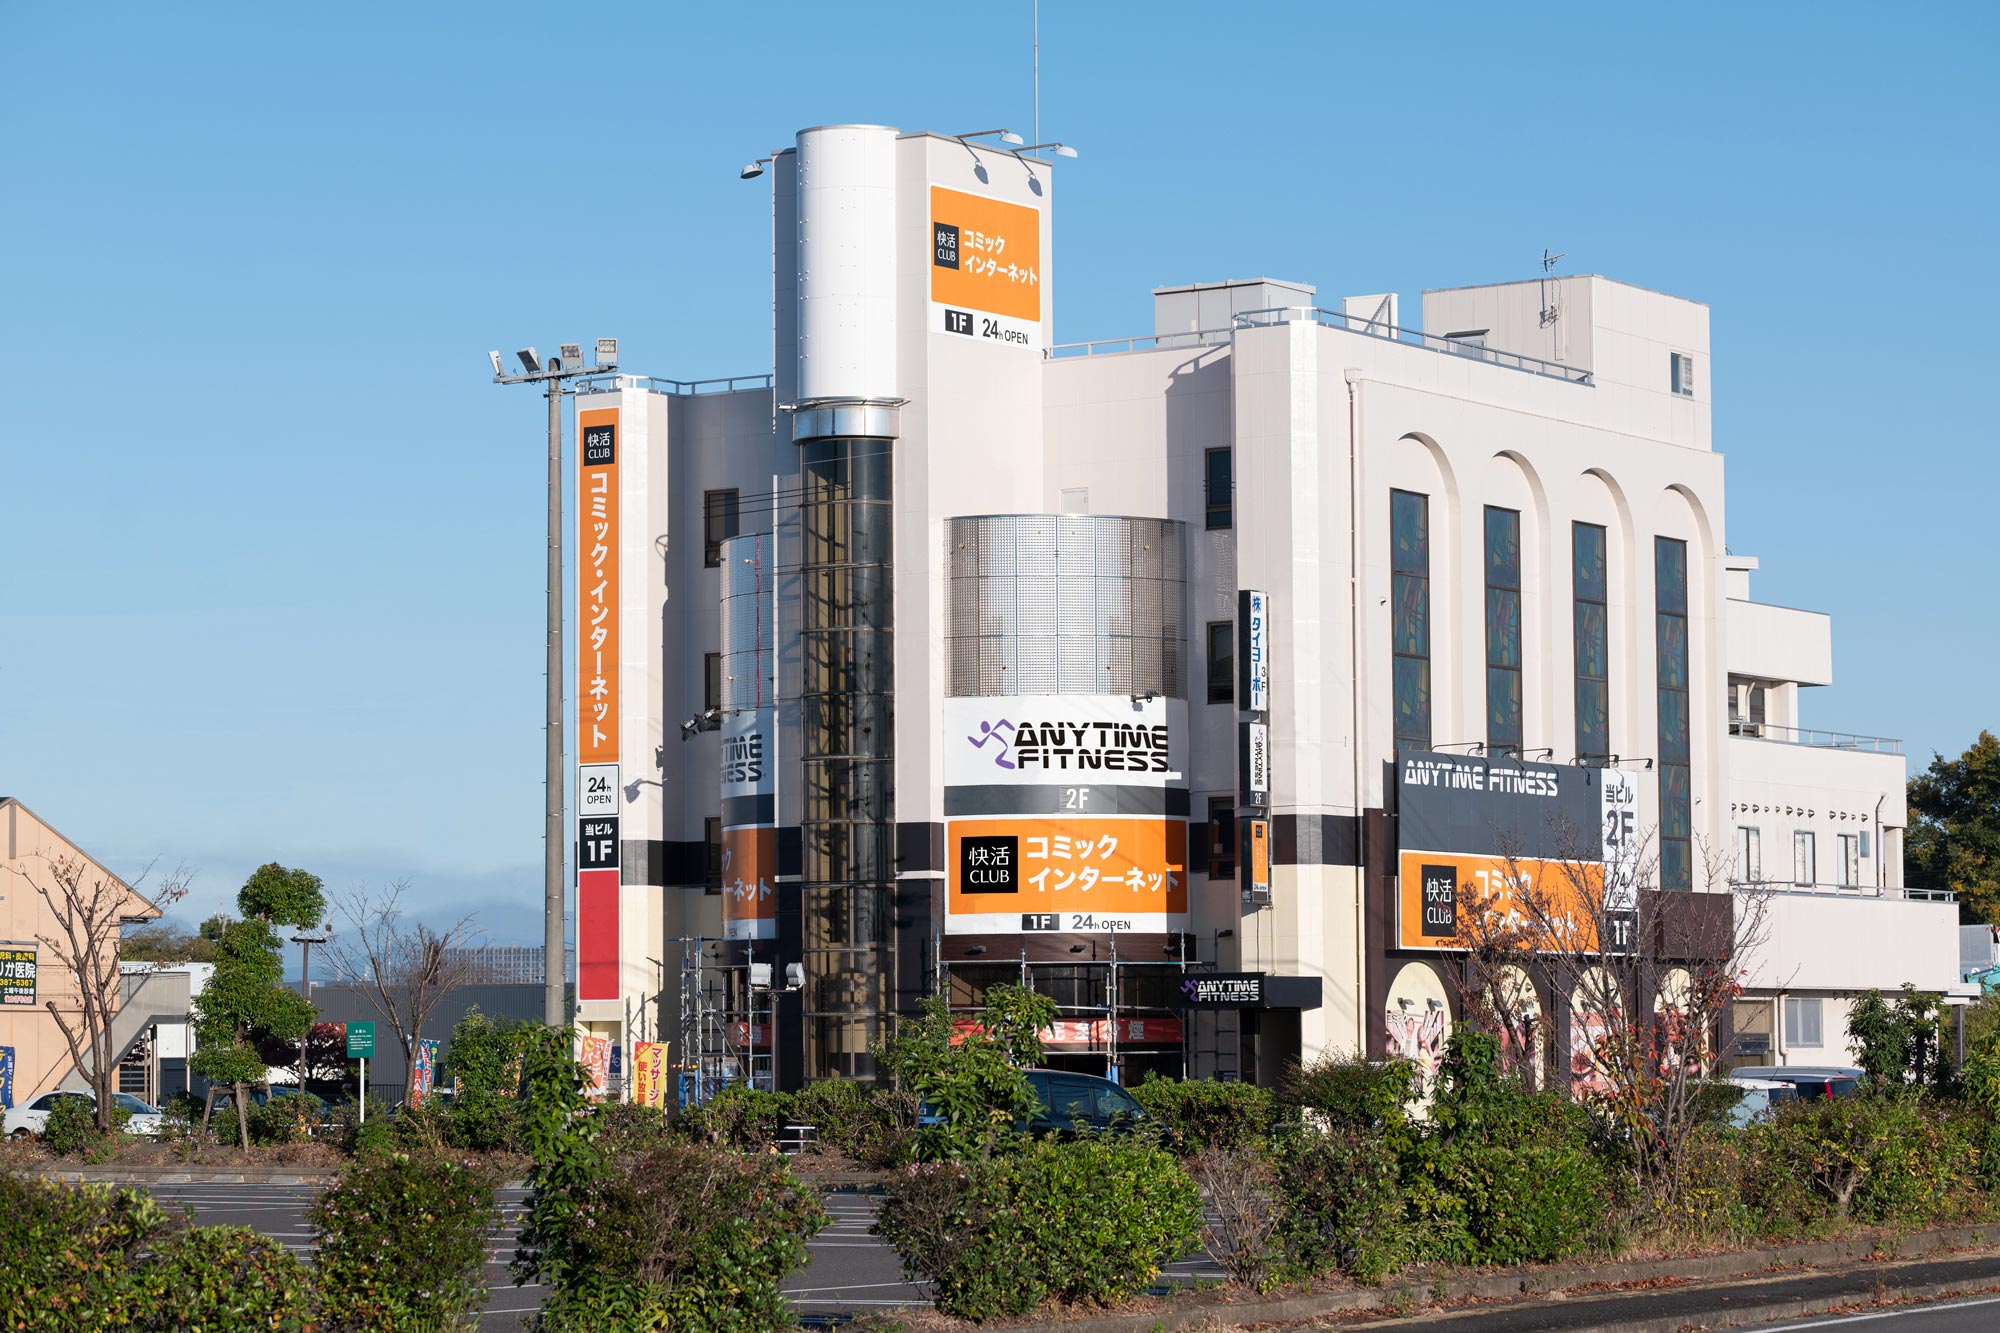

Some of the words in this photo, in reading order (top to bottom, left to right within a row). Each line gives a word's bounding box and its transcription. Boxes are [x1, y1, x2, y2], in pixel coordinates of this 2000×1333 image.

[937, 231, 956, 248] 快活
[964, 229, 1005, 254] コミック
[937, 249, 956, 262] CLUB
[965, 255, 1038, 286] インターネット
[952, 313, 967, 331] 1F
[1004, 330, 1028, 345] OPEN
[588, 432, 611, 447] 快活
[588, 448, 611, 459] CLUB
[1014, 722, 1169, 750] ANYTIME
[1018, 749, 1169, 773] FITNESS
[1404, 759, 1484, 791] ANYTIME
[1489, 768, 1558, 797] FITNESS
[587, 795, 612, 804] OPEN
[1066, 788, 1089, 809] 2F
[1255, 792, 1262, 805] 2F
[1606, 784, 1634, 804] 当ビル
[585, 824, 613, 836] 当ビル
[1606, 809, 1634, 847] 2F
[587, 840, 613, 862] 1F
[1027, 834, 1119, 860] コミック
[968, 846, 1010, 867] 快活
[969, 869, 1010, 884] CLUB
[1027, 866, 1178, 893] インターネット
[1426, 878, 1452, 903] 快活
[1031, 915, 1051, 929] 1F
[1072, 914, 1100, 930] 24h
[1101, 919, 1131, 931] OPEN
[1426, 907, 1452, 924] CLUB
[1197, 979, 1259, 992] ANYTIME
[1198, 992, 1259, 1002] FITNESS
